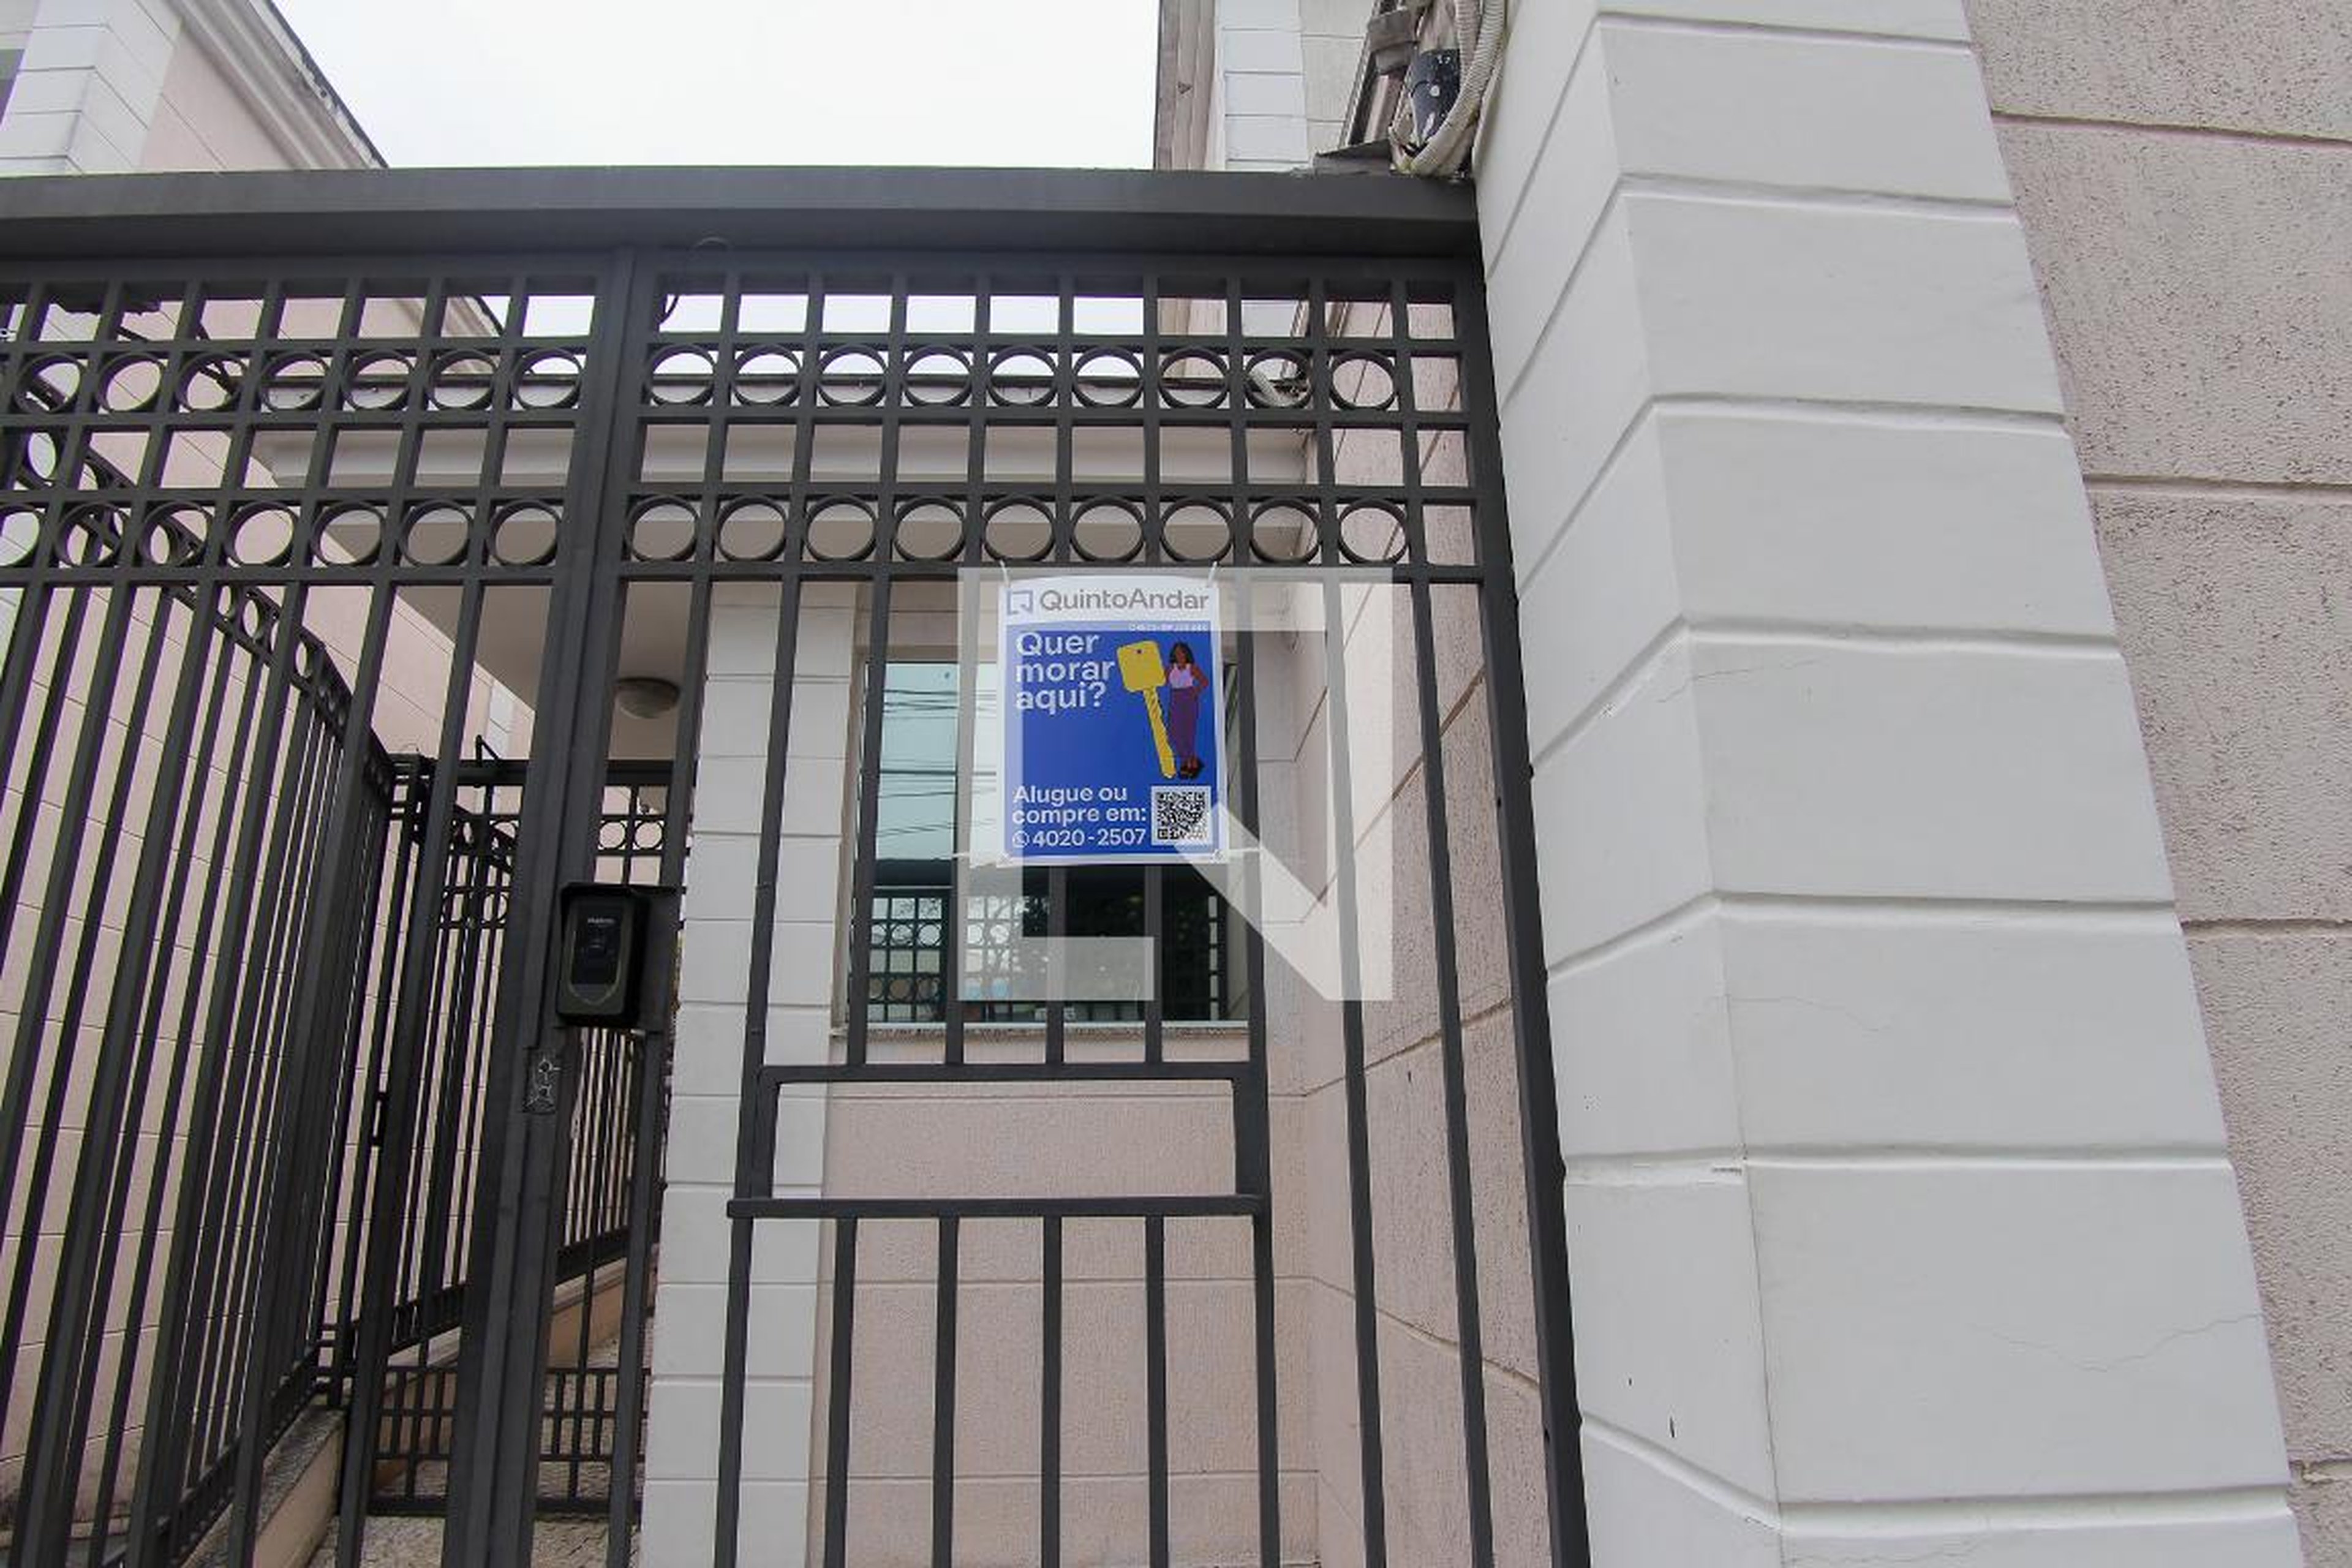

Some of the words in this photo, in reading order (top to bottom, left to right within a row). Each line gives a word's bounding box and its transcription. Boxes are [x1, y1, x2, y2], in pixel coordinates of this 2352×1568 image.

[1039, 588, 1209, 611] QuintoAndar
[1015, 631, 1100, 657] Quer
[1015, 660, 1116, 683] morar
[1016, 680, 1107, 716] aqui?
[1012, 785, 1093, 807] Alugue
[1098, 787, 1127, 802] ou
[1012, 807, 1100, 827] compre
[1106, 807, 1147, 823] em:
